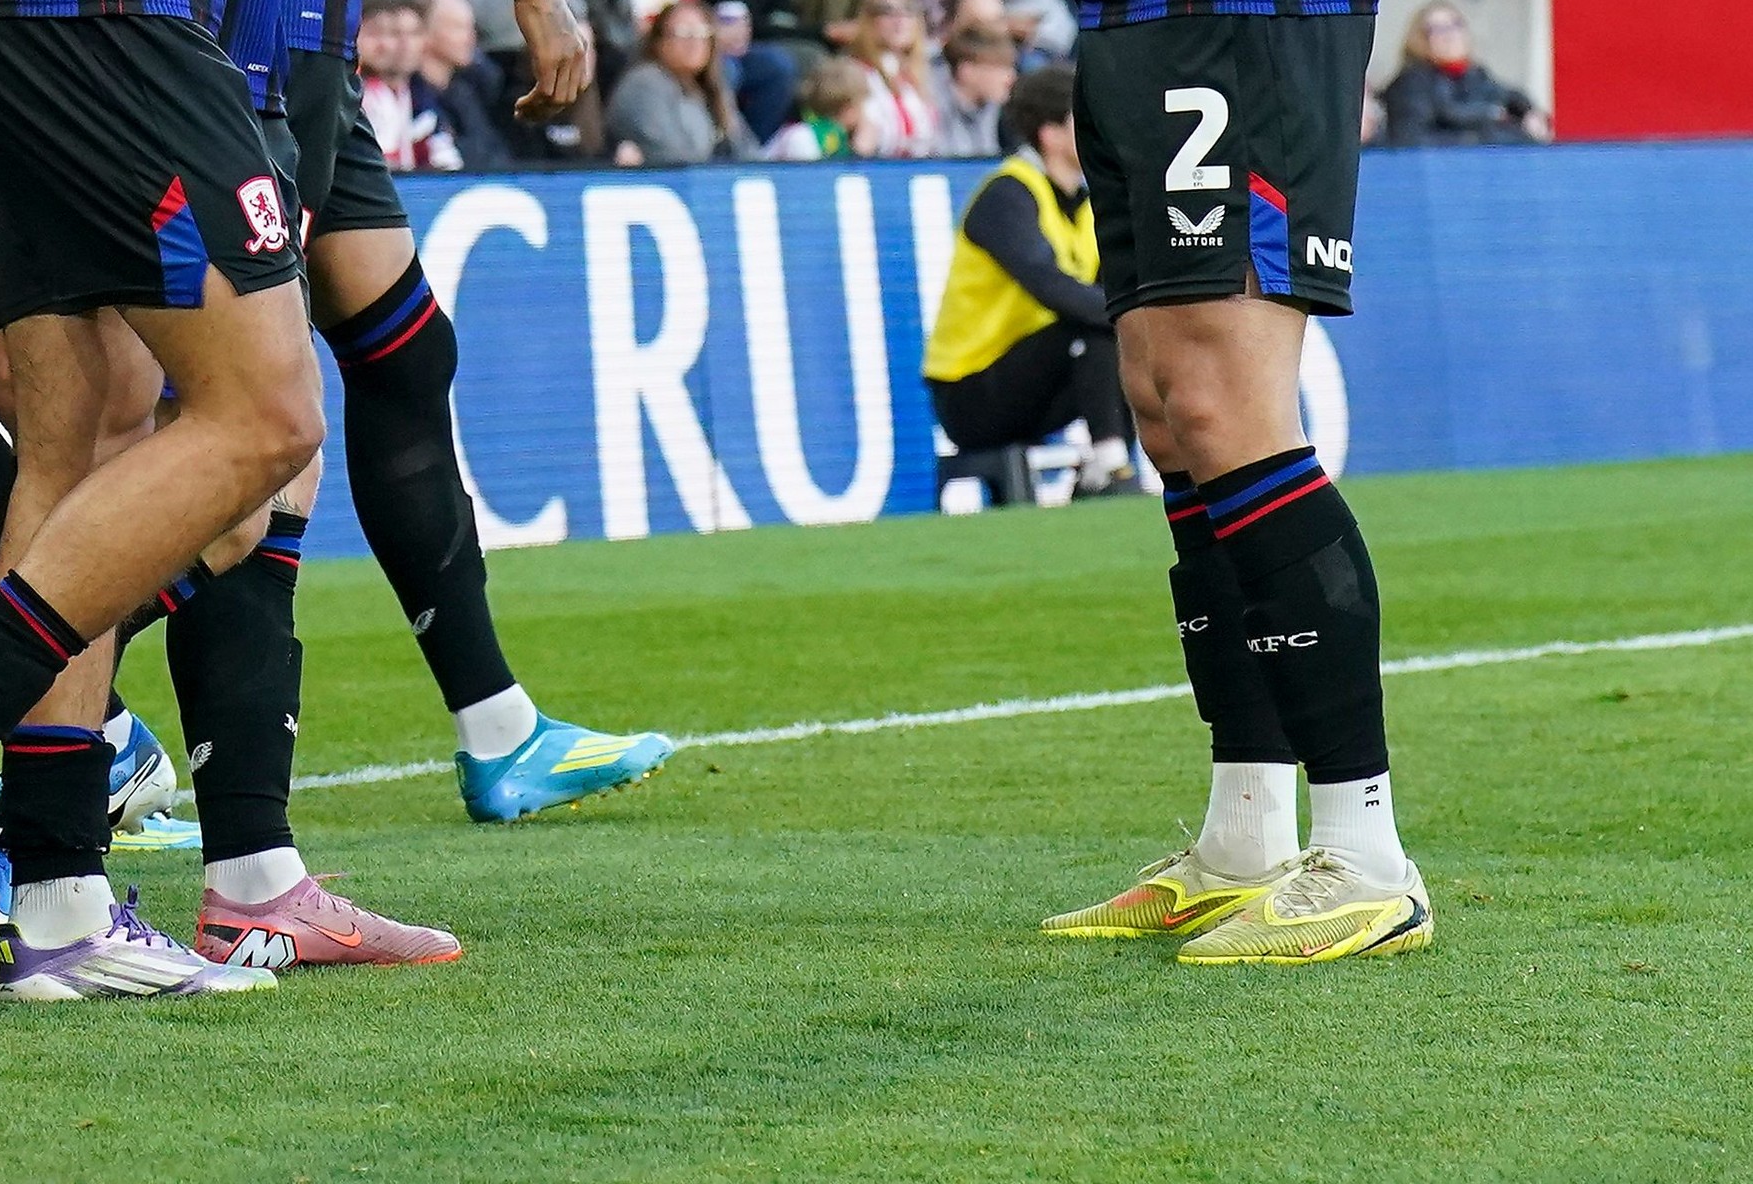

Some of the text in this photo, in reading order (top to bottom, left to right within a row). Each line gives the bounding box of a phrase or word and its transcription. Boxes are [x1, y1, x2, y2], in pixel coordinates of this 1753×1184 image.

[1165, 87, 1231, 192] 2
[1170, 236, 1224, 247] CASTORE
[1306, 235, 1353, 274] NO
[1177, 615, 1208, 638] FC
[1246, 630, 1318, 653] MFC
[1365, 783, 1380, 807] RE
